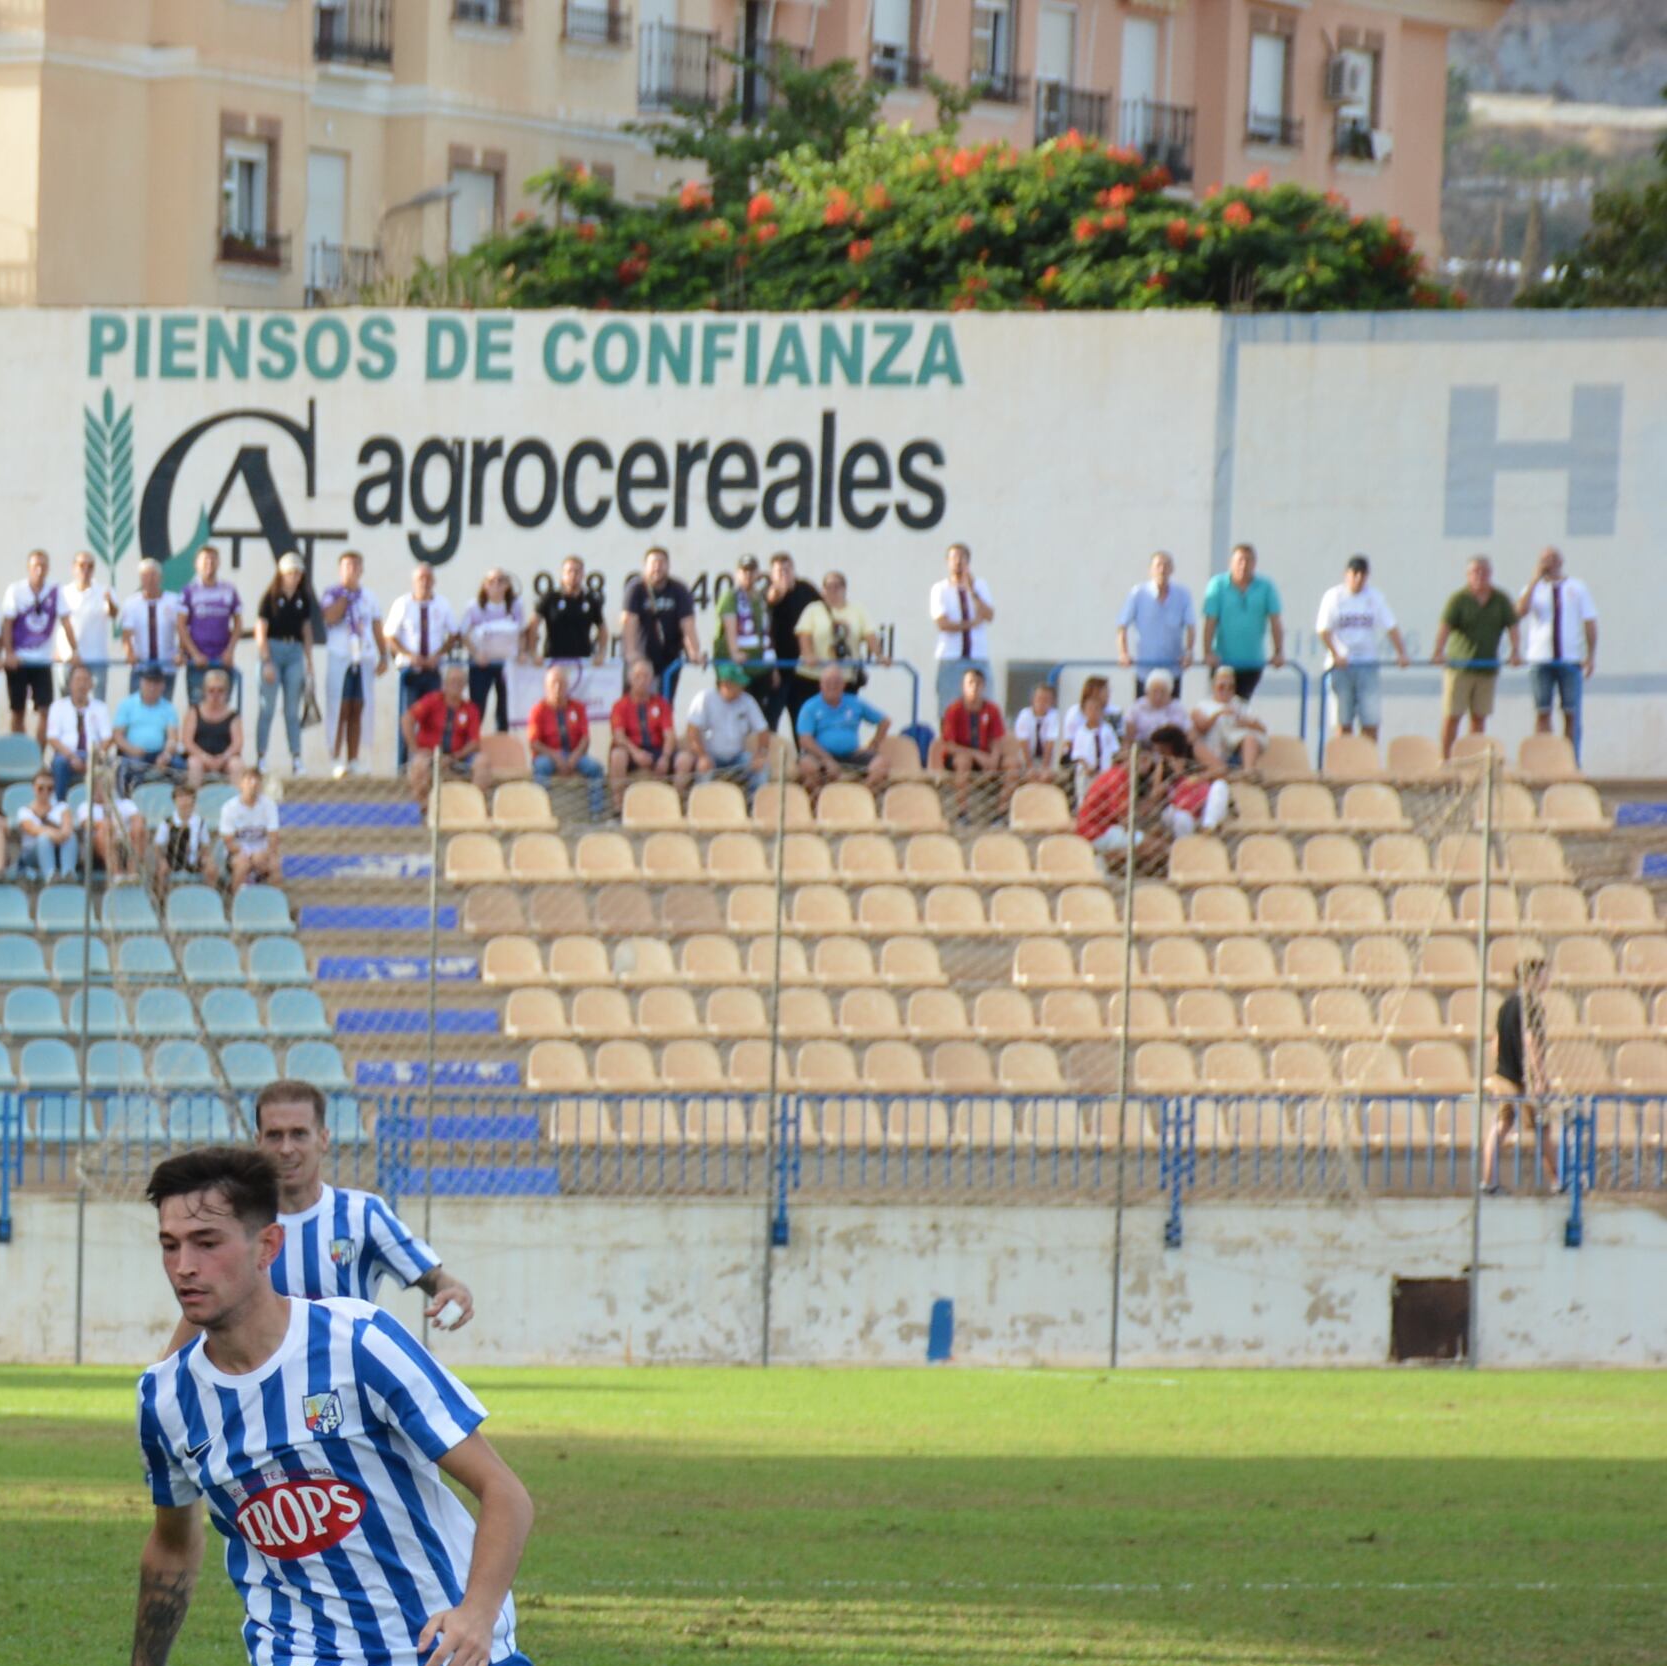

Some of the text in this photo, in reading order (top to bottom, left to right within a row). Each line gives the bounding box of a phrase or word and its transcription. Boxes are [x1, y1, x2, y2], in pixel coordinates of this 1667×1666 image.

[87, 315, 964, 387] PIENSOS DE CONFIANZA
[353, 409, 946, 566] agrocereales
[237, 1484, 361, 1547] TROPS
